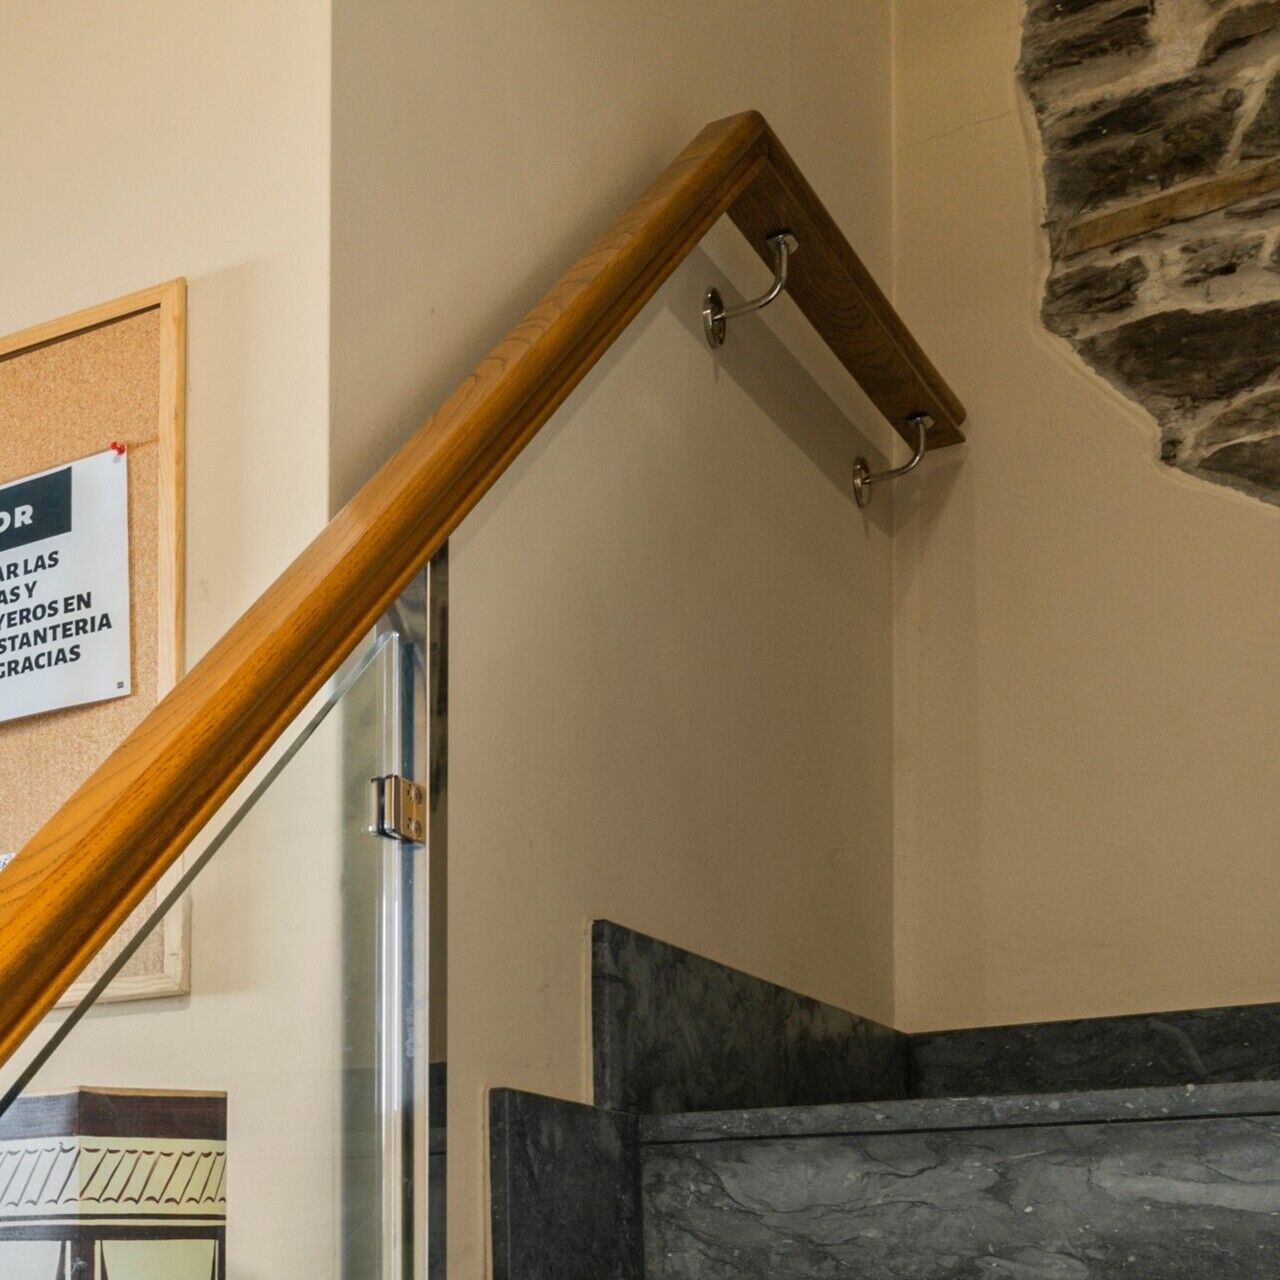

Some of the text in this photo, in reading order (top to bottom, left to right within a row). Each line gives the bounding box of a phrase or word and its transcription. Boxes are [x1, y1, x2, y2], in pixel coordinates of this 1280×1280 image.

[23, 550, 60, 576] LAS
[23, 580, 38, 600] Y
[63, 591, 93, 617] EN
